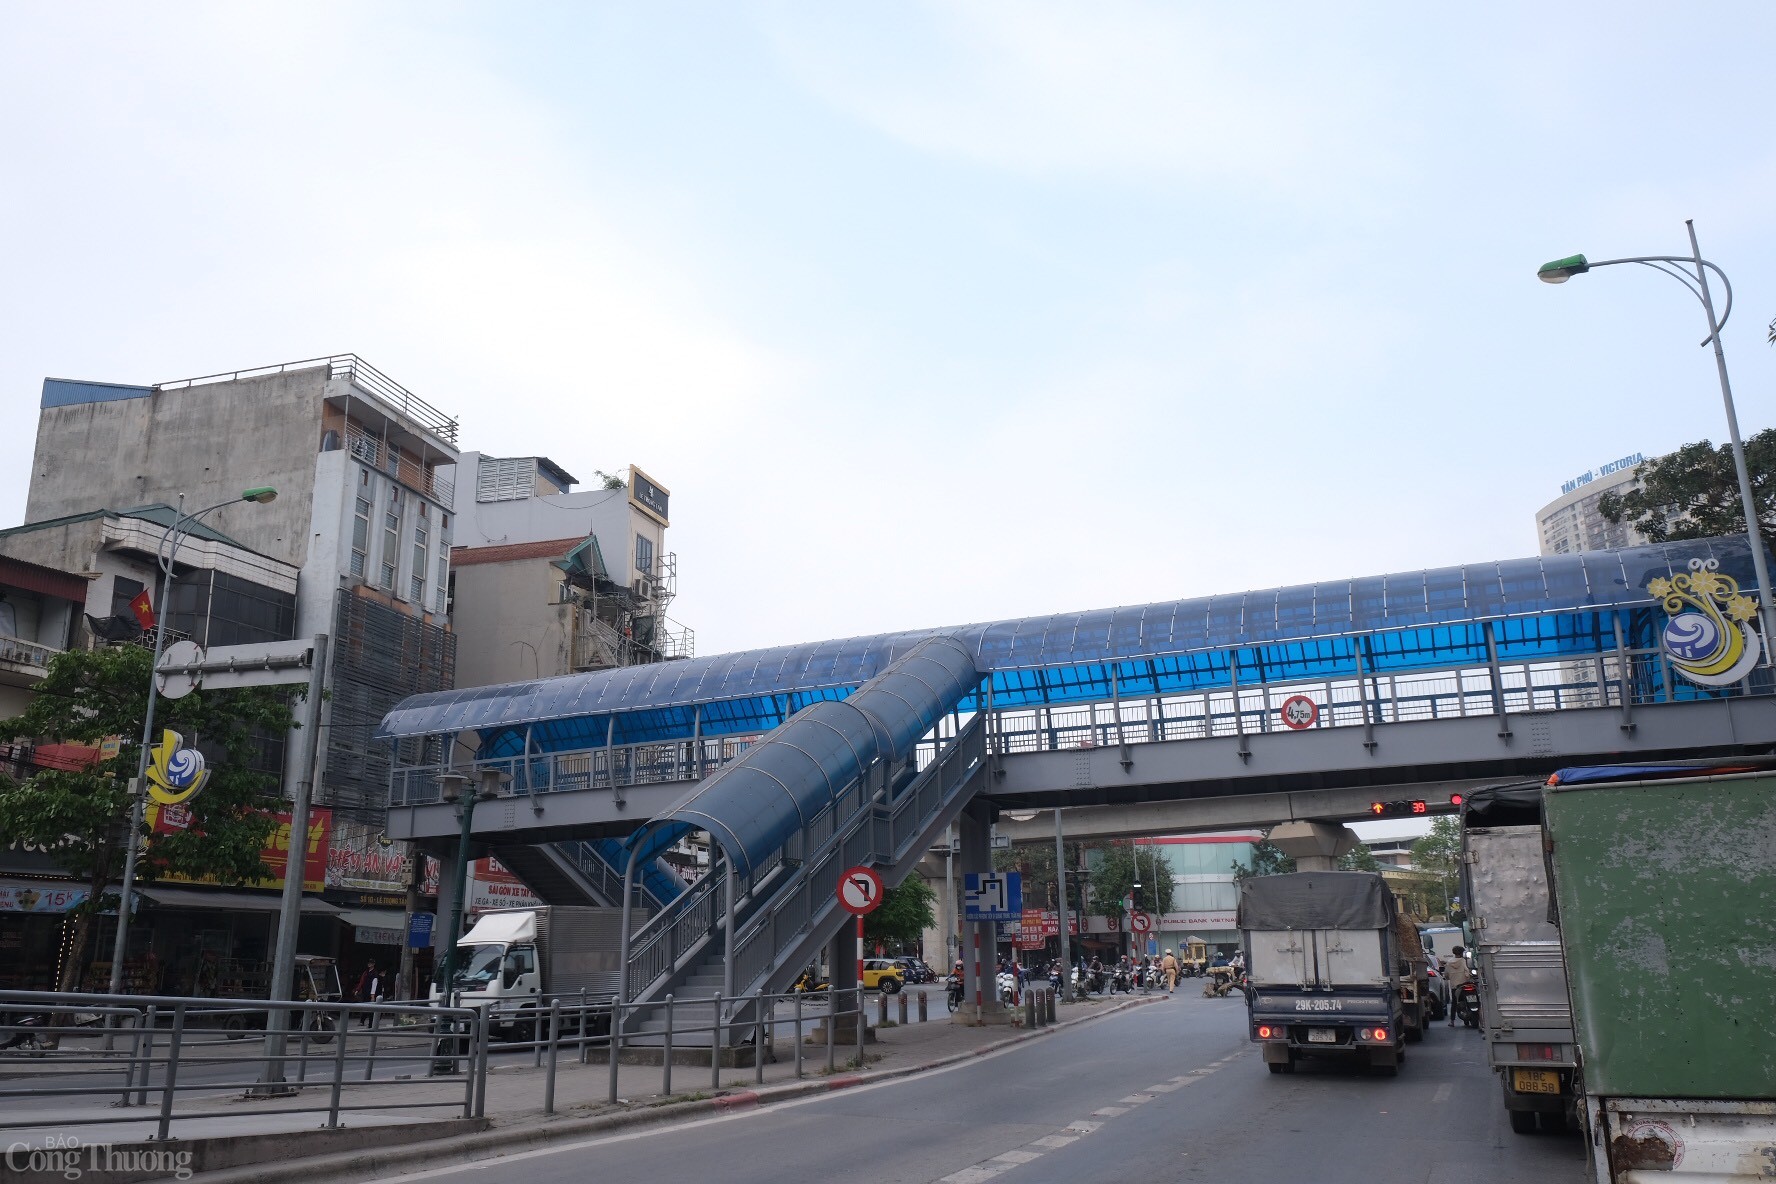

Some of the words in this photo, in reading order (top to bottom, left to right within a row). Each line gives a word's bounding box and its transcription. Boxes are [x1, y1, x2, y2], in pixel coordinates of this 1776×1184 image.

[1561, 480, 1576, 494] VĂN
[1600, 452, 1643, 477] VICTORIA
[1287, 706, 1311, 720] 4,75m
[1412, 802, 1425, 813] 39
[1296, 999, 1342, 1011] 29K-205.74
[1527, 1071, 1546, 1082] 18C
[1519, 1080, 1555, 1093] 088.58
